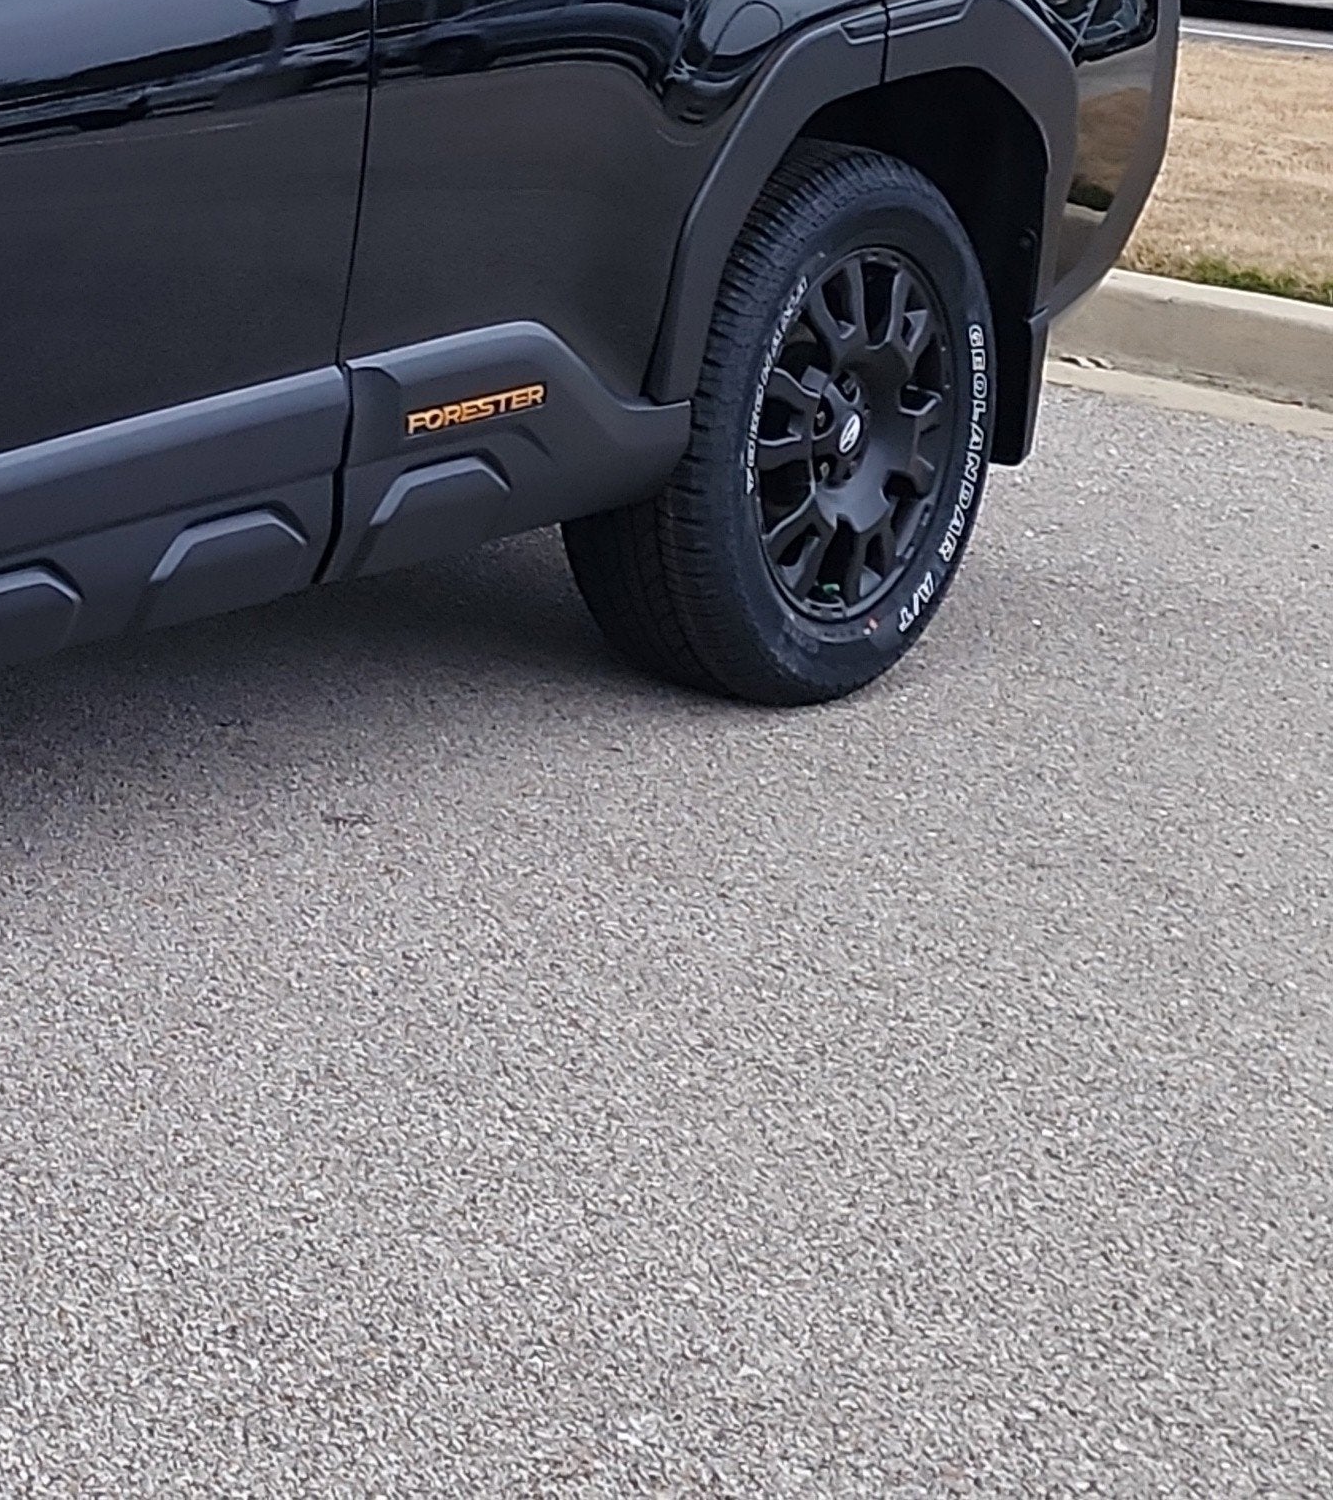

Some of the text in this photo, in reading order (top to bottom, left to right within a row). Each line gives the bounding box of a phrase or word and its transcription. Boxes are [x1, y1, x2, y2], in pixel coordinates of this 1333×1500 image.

[406, 384, 545, 435] FORESTER
[898, 323, 988, 633] GEOLANDAR A/T
